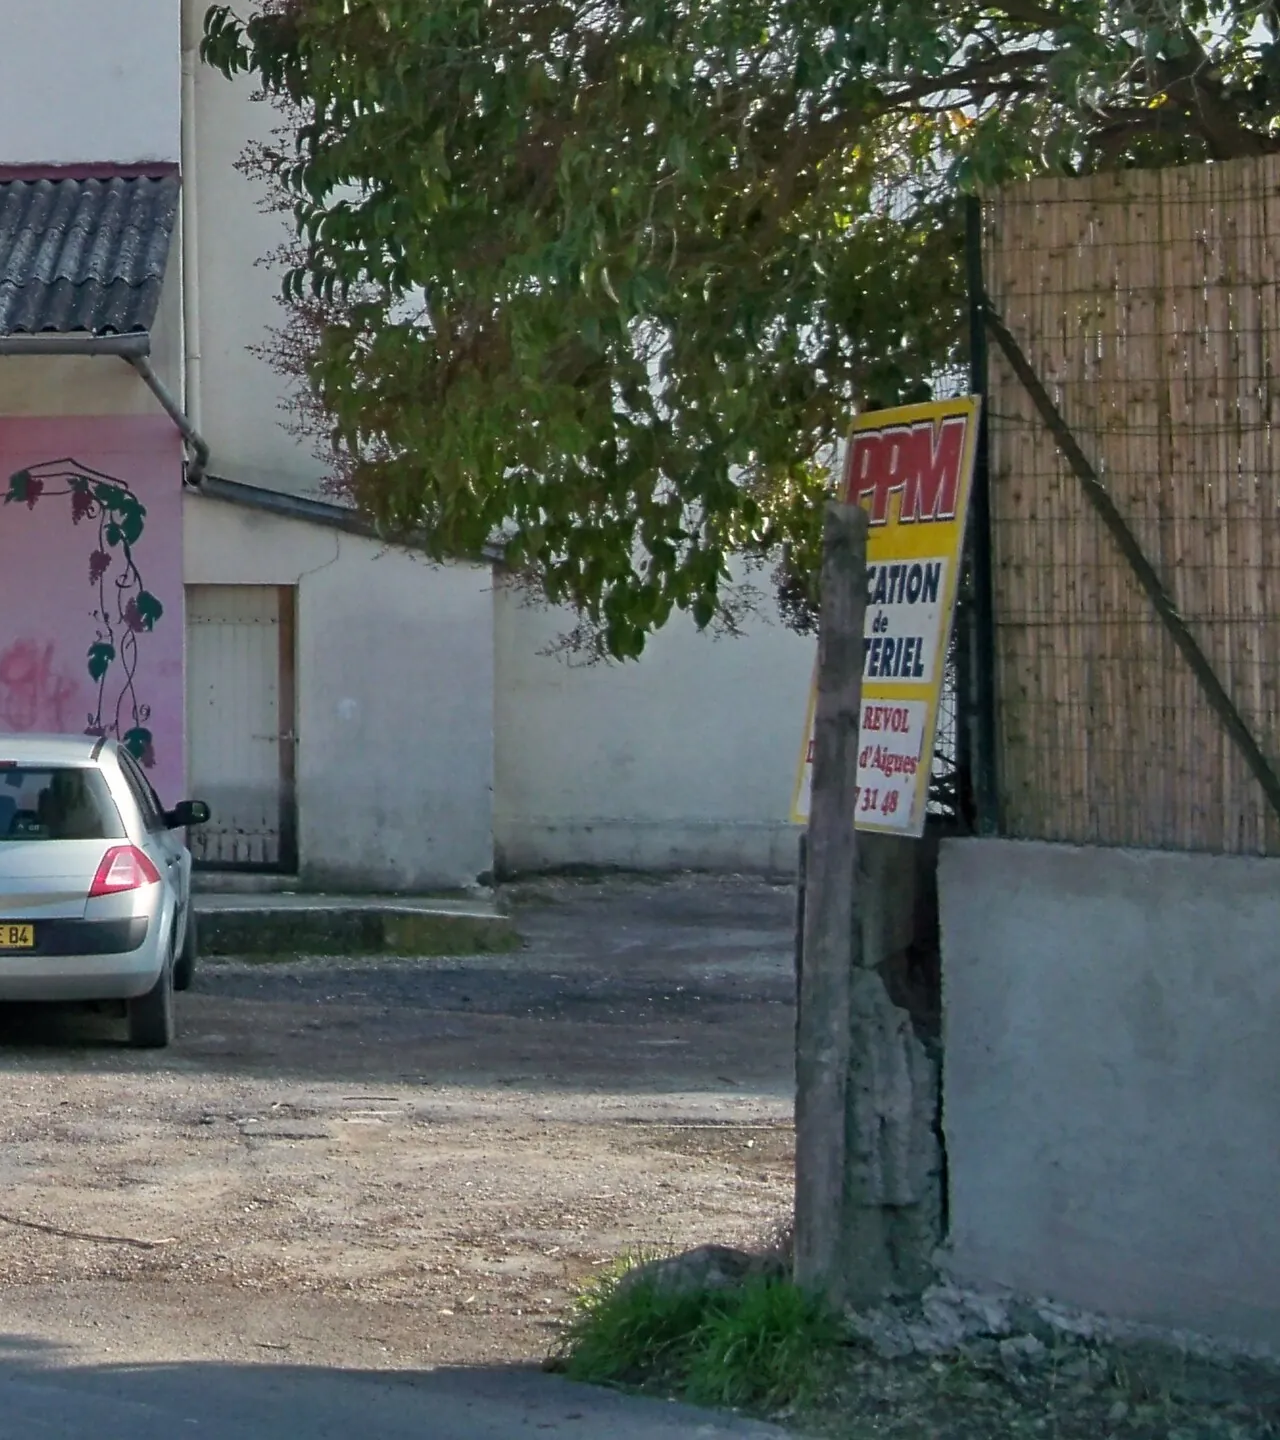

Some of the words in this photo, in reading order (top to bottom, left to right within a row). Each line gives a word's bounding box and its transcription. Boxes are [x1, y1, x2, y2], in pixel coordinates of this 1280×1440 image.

[847, 412, 969, 529] PPM
[866, 562, 942, 605] CATION
[872, 609, 889, 633] de
[863, 636, 925, 678] TERIEL
[862, 706, 910, 734] REVOL
[861, 787, 879, 812] 31
[880, 789, 899, 816] 48
[9, 927, 29, 944] 84
